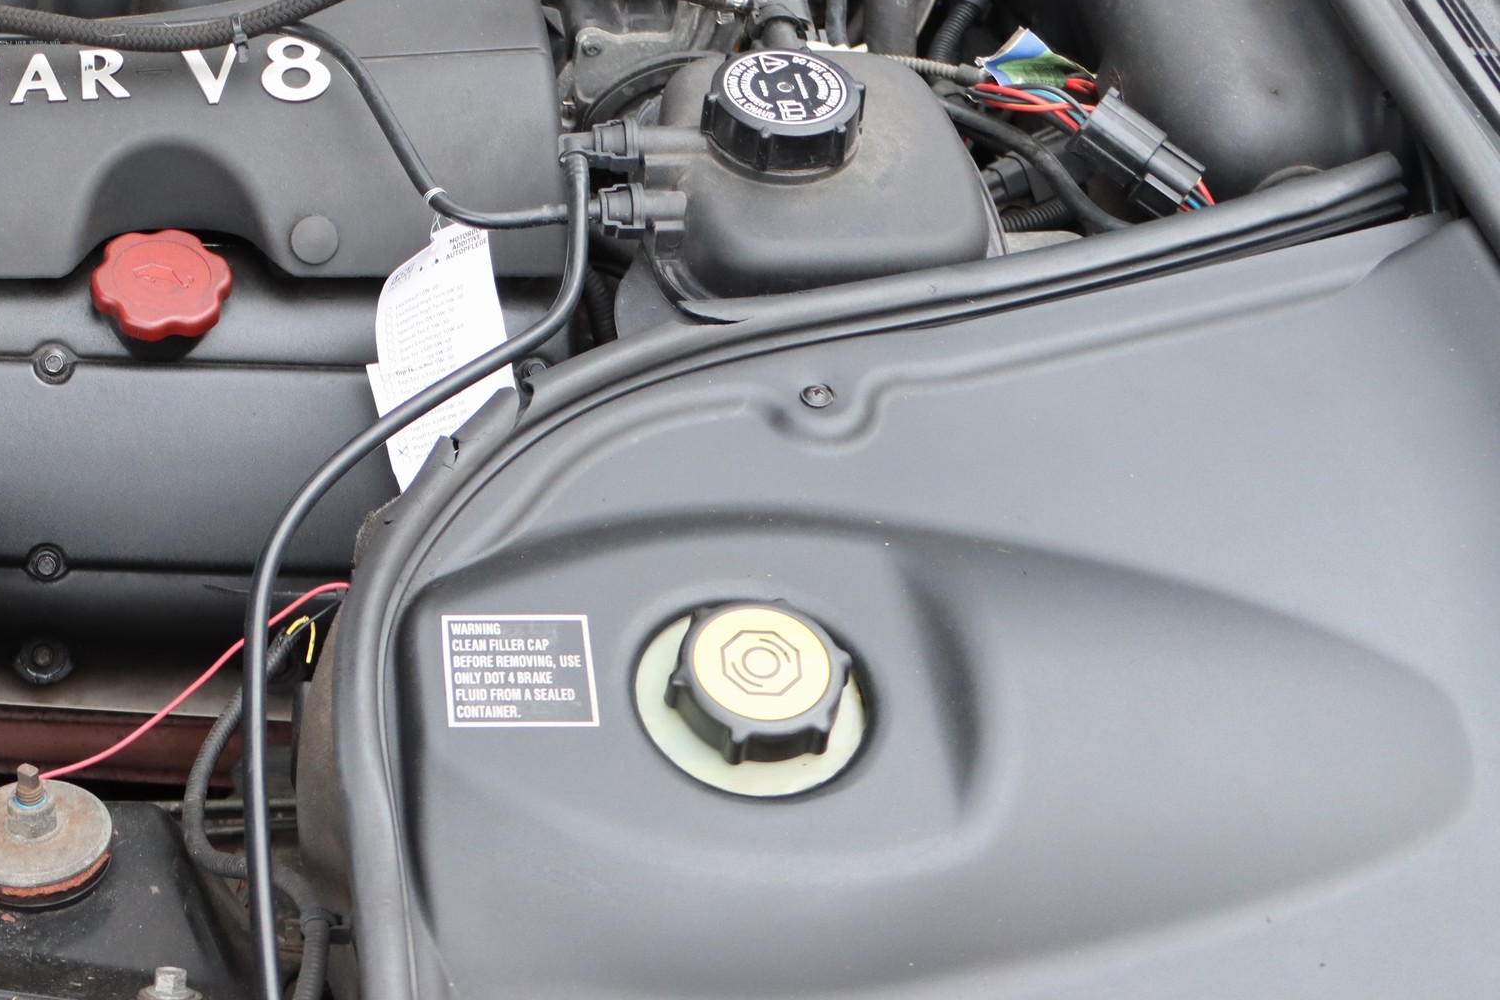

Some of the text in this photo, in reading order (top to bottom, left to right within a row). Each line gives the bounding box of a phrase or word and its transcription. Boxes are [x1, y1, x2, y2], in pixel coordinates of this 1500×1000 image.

[792, 56, 807, 66] DO
[807, 60, 826, 74] NOT
[182, 36, 332, 105] V8
[742, 102, 776, 120] CHAUD
[813, 104, 832, 118] HOT
[452, 233, 482, 250] ADDITIVE
[446, 238, 487, 261] AUTOPFLEGE
[450, 623, 501, 636] WARNING
[452, 639, 550, 652] CLEAN FILLER CAP
[453, 655, 582, 669] BEFORE REMOVING, USE
[454, 672, 553, 685] ONLY DOT 4 BRAKE
[456, 688, 576, 702] FLUID FROM A SEALED
[456, 705, 522, 719] CONTAINER.
